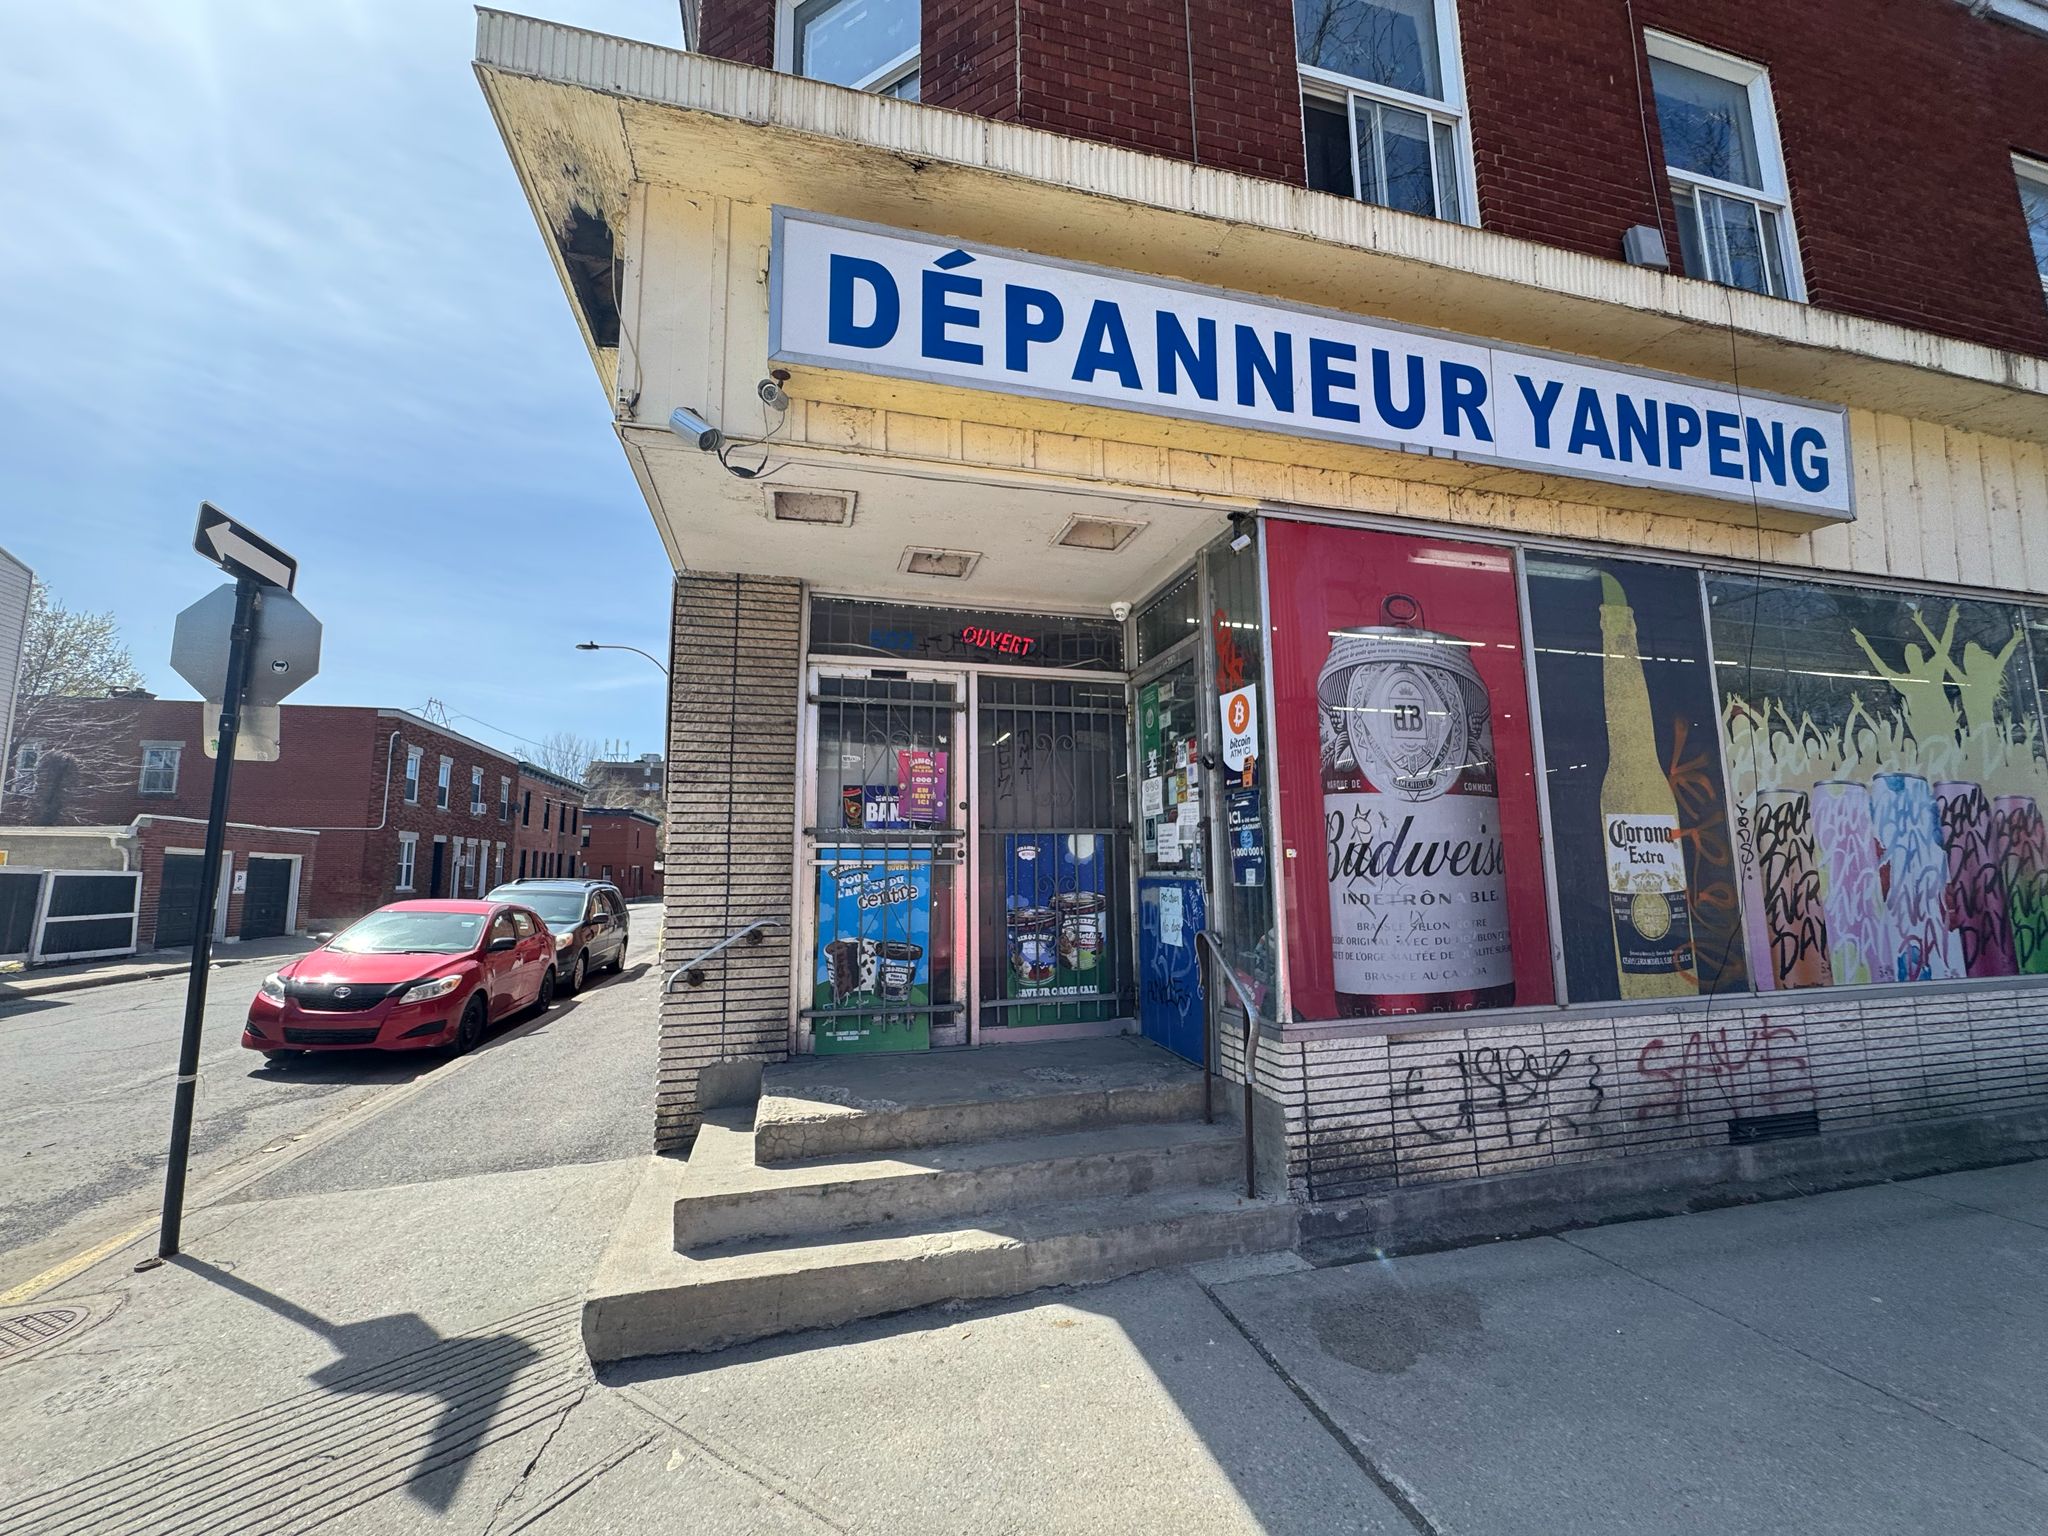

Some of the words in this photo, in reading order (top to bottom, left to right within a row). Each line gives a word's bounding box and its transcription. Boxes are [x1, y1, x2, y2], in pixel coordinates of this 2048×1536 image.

[827, 248, 1494, 442] DÉPANNEUR
[1514, 374, 1830, 493] YANPENG
[962, 626, 1036, 656] OUVERT
[1230, 735, 1251, 750] bitcoin
[1230, 748, 1242, 759] ATM
[1243, 746, 1251, 755] ICI
[1352, 779, 1361, 788] DE
[866, 802, 909, 822] BAN
[1229, 810, 1241, 825] ICI
[1609, 819, 1675, 851] Corona
[1628, 846, 1665, 864] Extra
[839, 873, 869, 886] POUR
[889, 875, 905, 886] DU
[857, 884, 919, 910] centre
[1435, 937, 1450, 946] DU
[1771, 916, 1828, 980] DAY
[1440, 951, 1455, 960] DE
[1423, 972, 1439, 980] AU
